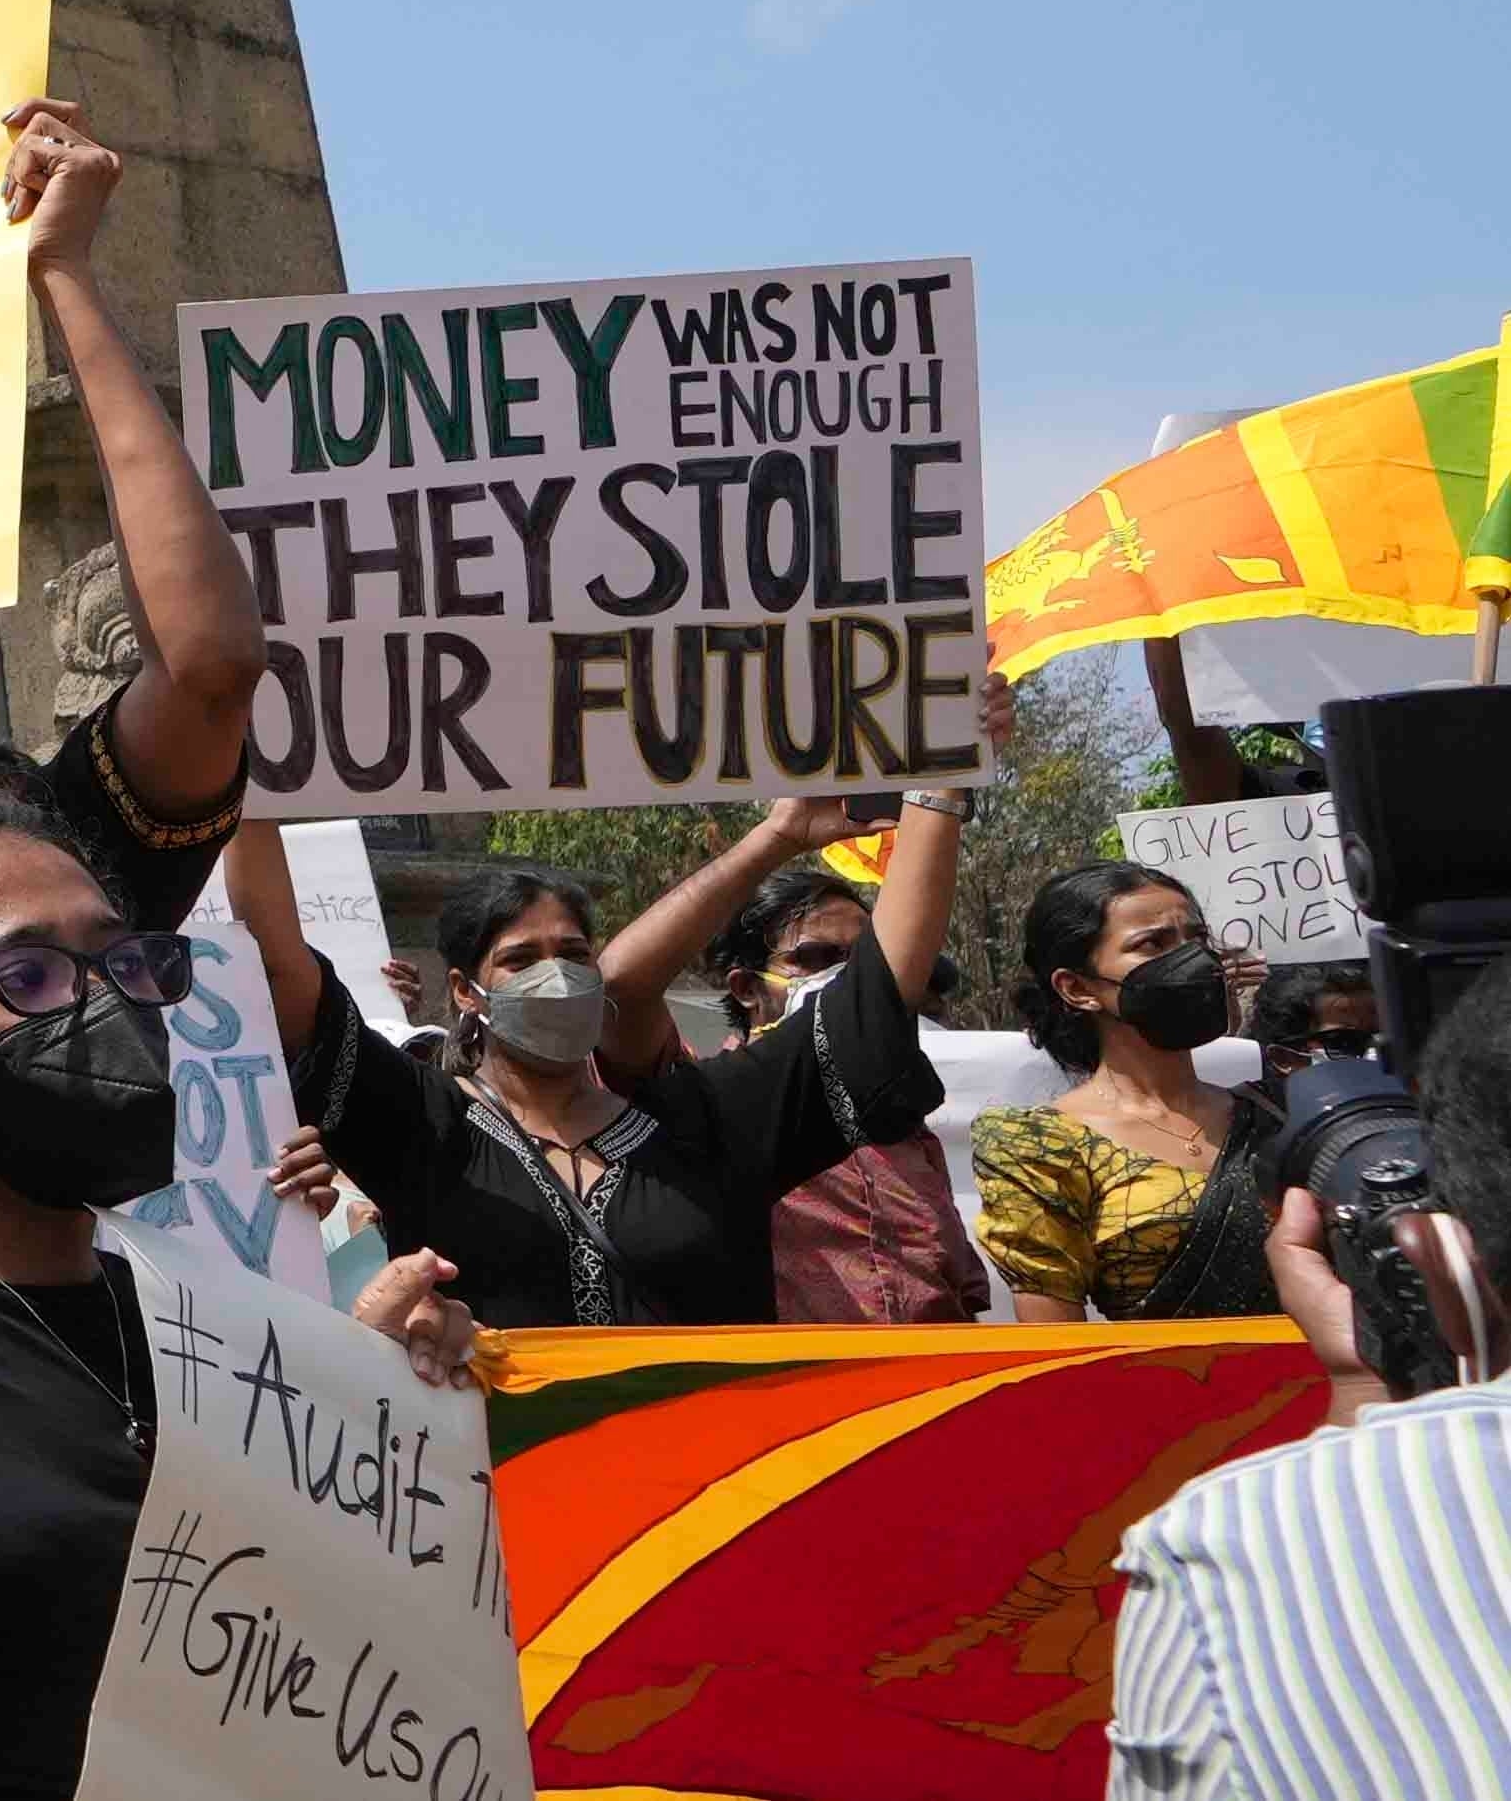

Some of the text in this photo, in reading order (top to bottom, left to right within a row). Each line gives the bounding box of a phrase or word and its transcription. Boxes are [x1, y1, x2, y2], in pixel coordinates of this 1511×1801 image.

[201, 274, 952, 491] MONEY WAS NOT
[670, 359, 944, 448] ENOUGH
[221, 441, 970, 625] THEY STOLE
[246, 609, 983, 794] OUR FUTURE
[1132, 799, 1340, 868] GIVE US
[300, 893, 383, 937] stice,
[1219, 897, 1363, 951] ONEY
[1227, 853, 1349, 906] STOL
[171, 1054, 275, 1169] OT
